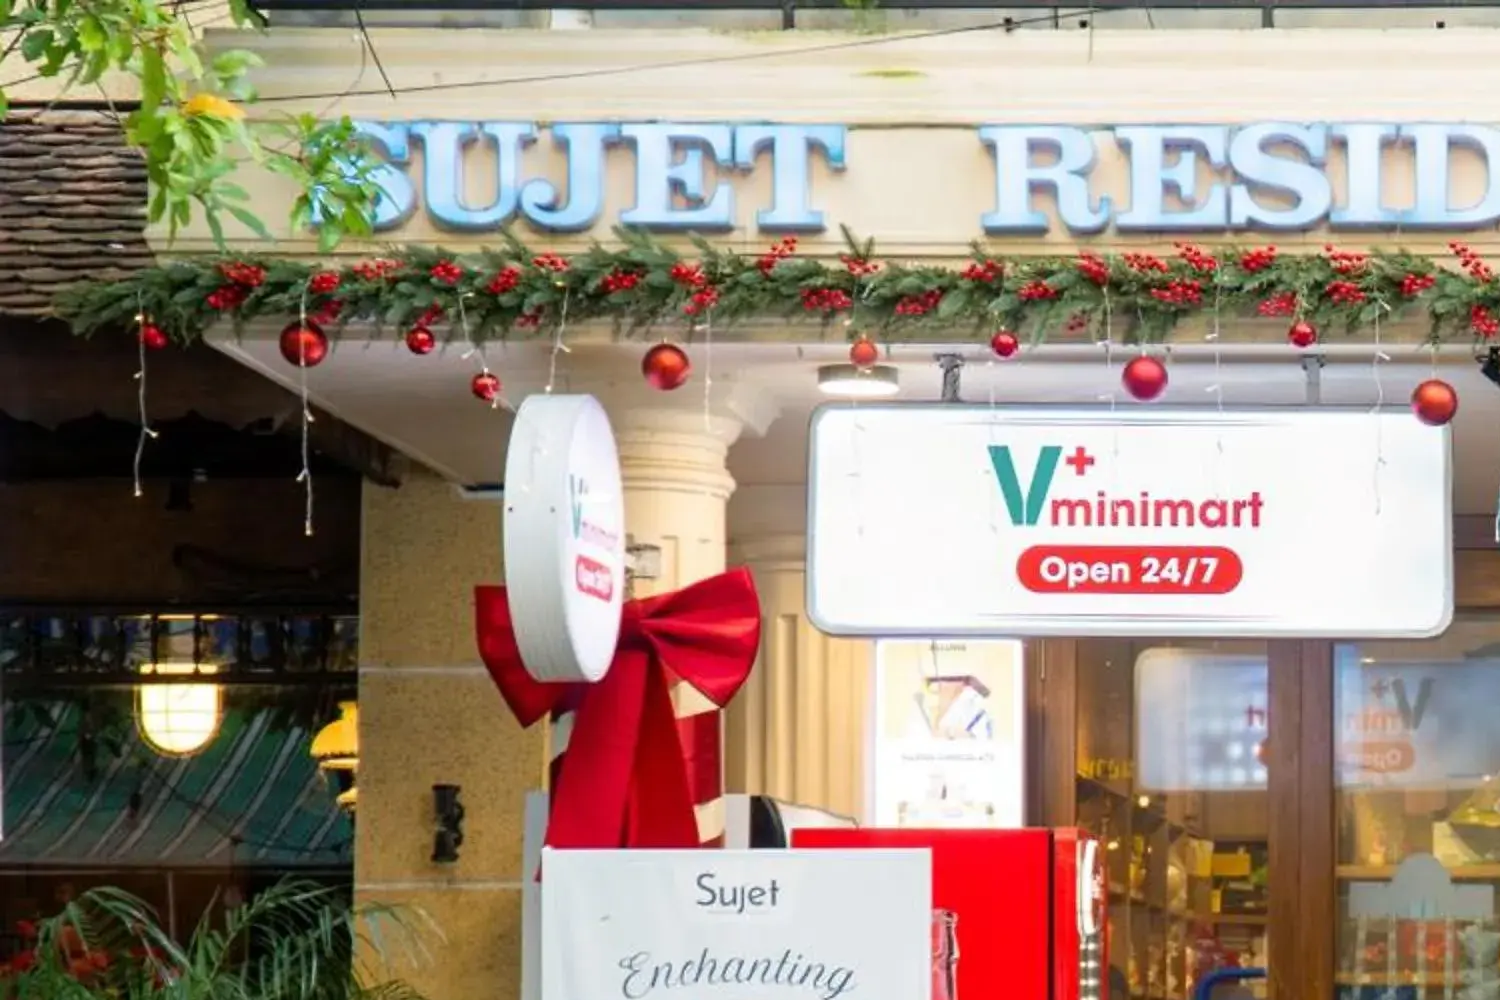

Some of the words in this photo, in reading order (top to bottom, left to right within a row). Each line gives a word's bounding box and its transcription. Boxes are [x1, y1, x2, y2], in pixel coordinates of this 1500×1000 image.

[312, 119, 848, 234] SUJET
[1050, 491, 1264, 529] minimart
[1039, 556, 1131, 593] Open
[1142, 556, 1219, 587] 24/7
[696, 872, 780, 914] Sujet
[618, 947, 857, 1000] Enchanting
